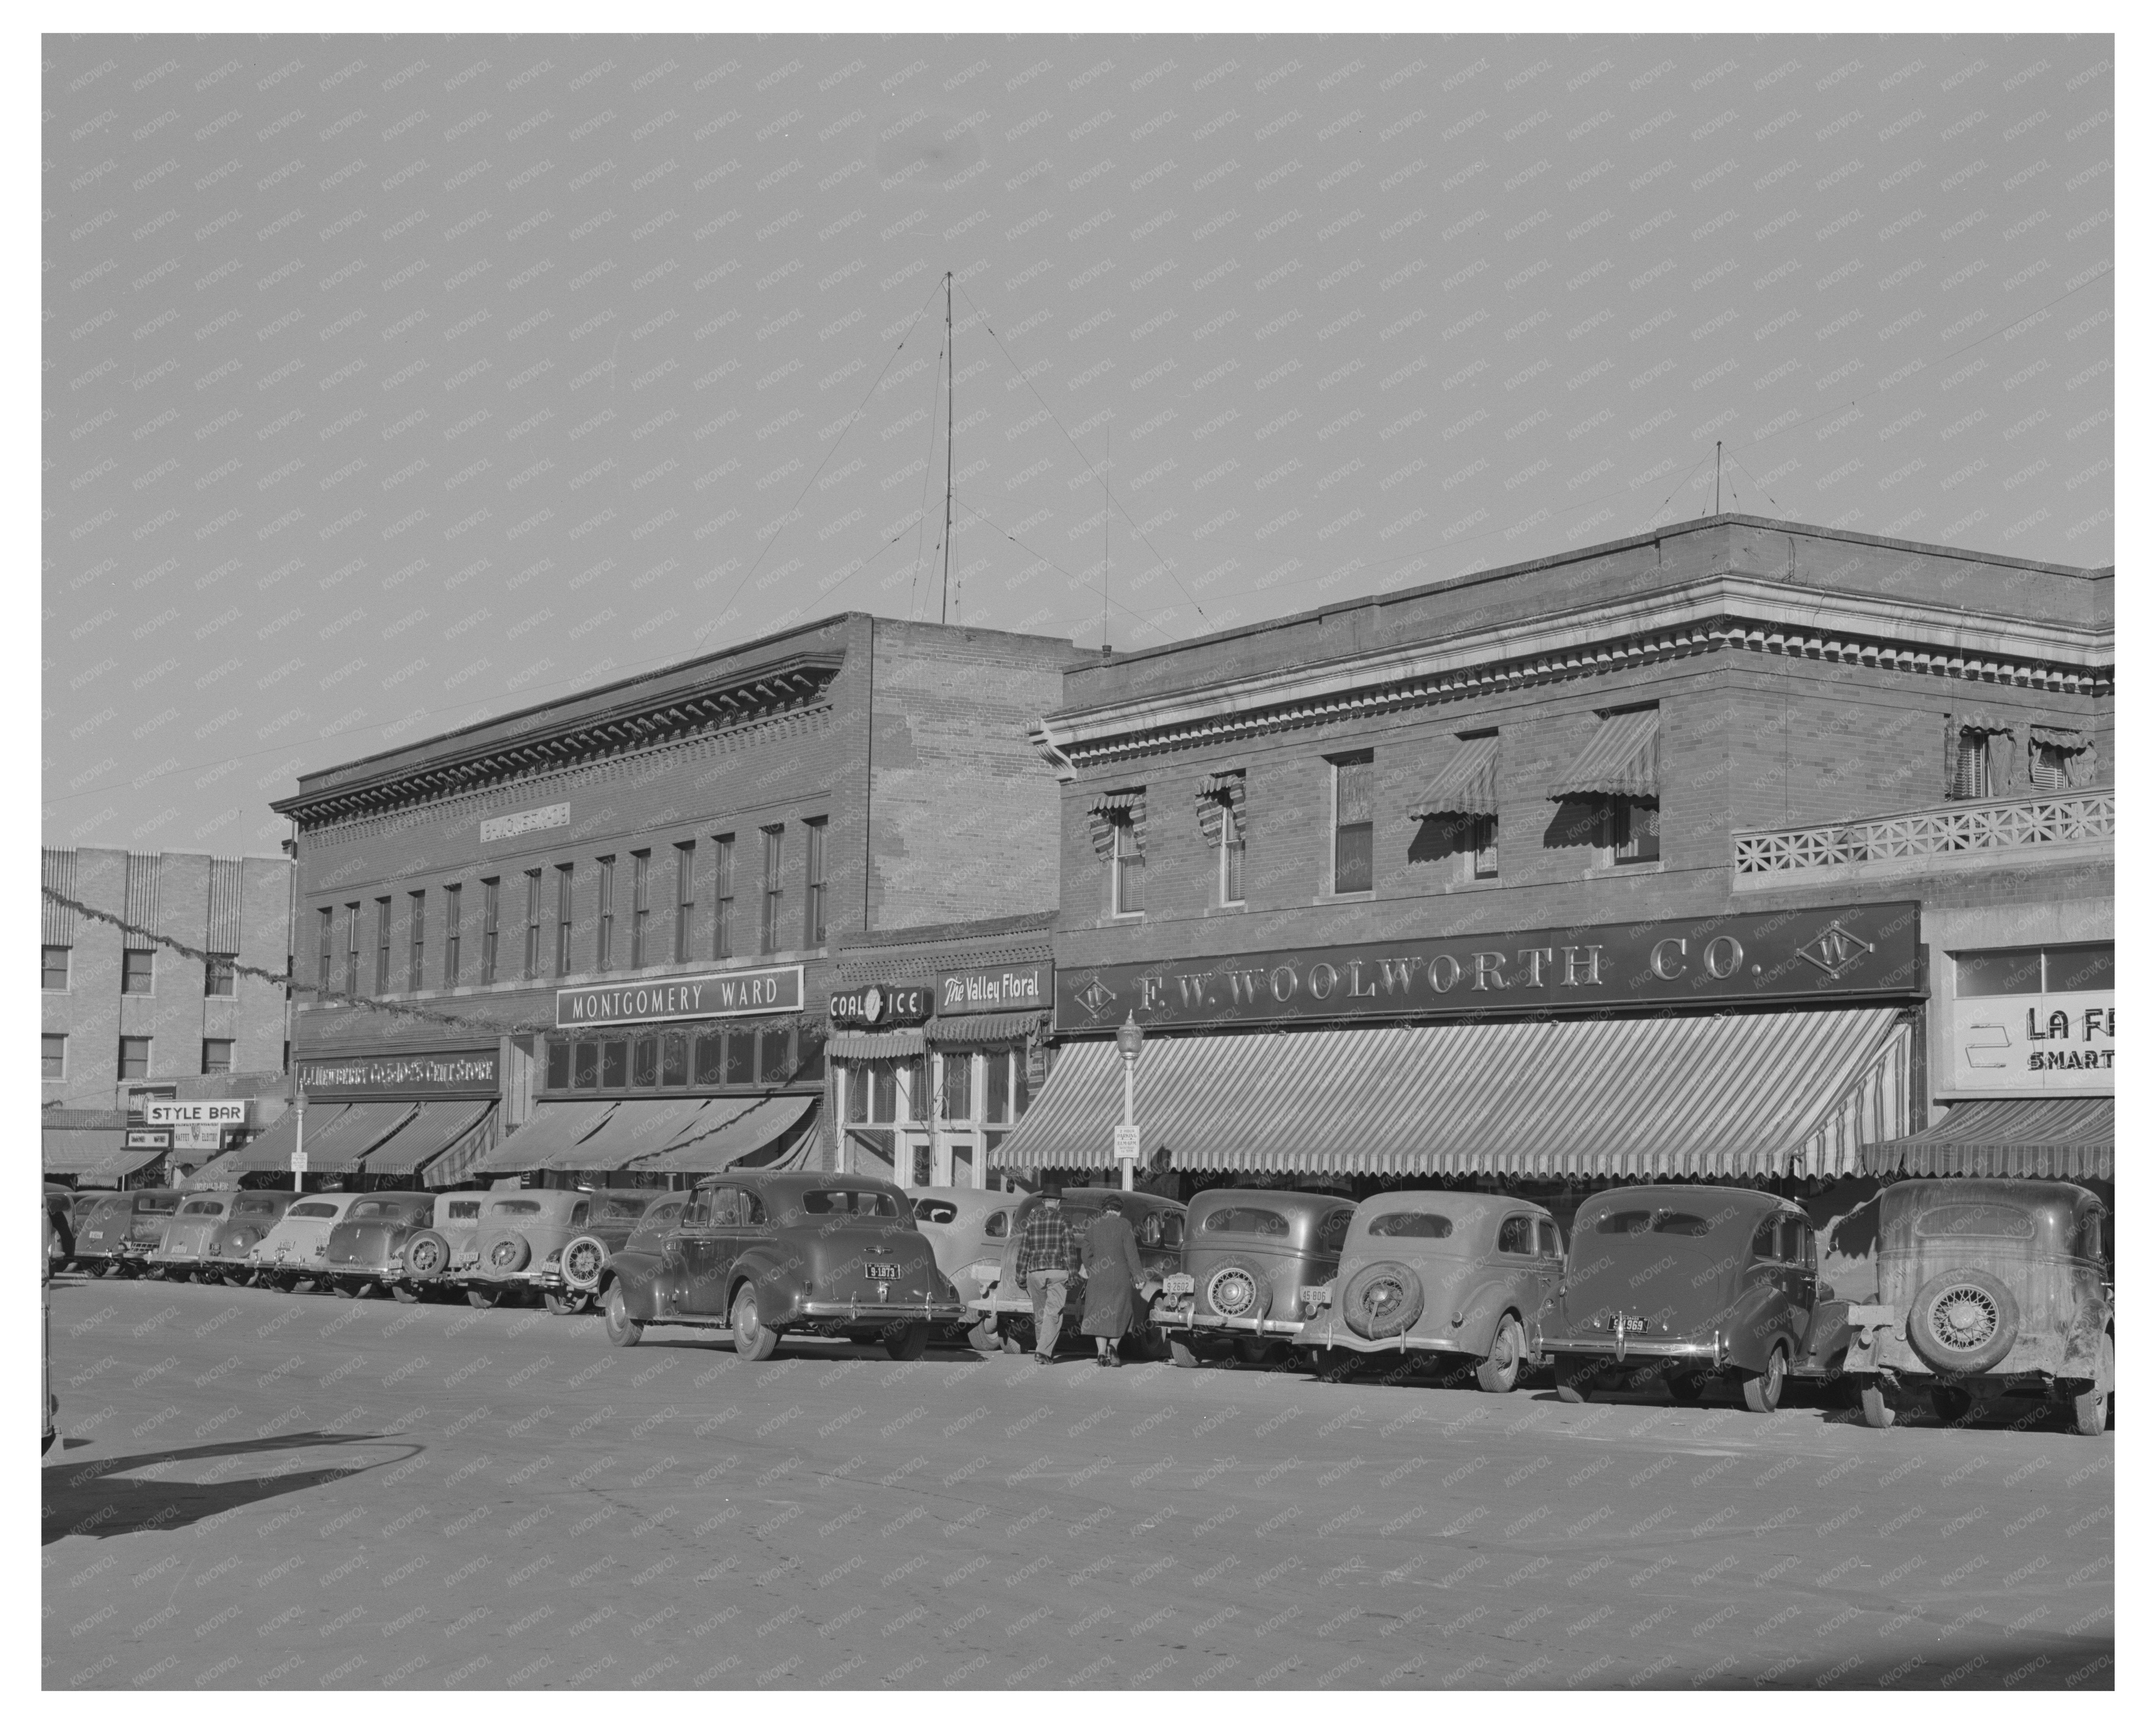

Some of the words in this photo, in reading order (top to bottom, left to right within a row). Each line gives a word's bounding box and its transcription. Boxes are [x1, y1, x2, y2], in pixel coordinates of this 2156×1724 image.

[1818, 932, 1849, 965] W
[1224, 945, 1603, 1004] WOOLWORTH
[1650, 935, 1762, 981] CO.
[573, 985, 702, 1019] MONTGOMERY
[722, 978, 777, 1007] WARD
[830, 996, 864, 1016] COAL
[889, 992, 918, 1013] ICE
[944, 976, 964, 1006] The
[966, 976, 1000, 1003] Valley
[1003, 971, 1039, 998] Floral
[2026, 1008, 2069, 1040] LA
[427, 1061, 455, 1082] CENT
[457, 1059, 493, 1081] STORE
[152, 1107, 202, 1119] STYLE
[209, 1107, 240, 1119] BAR
